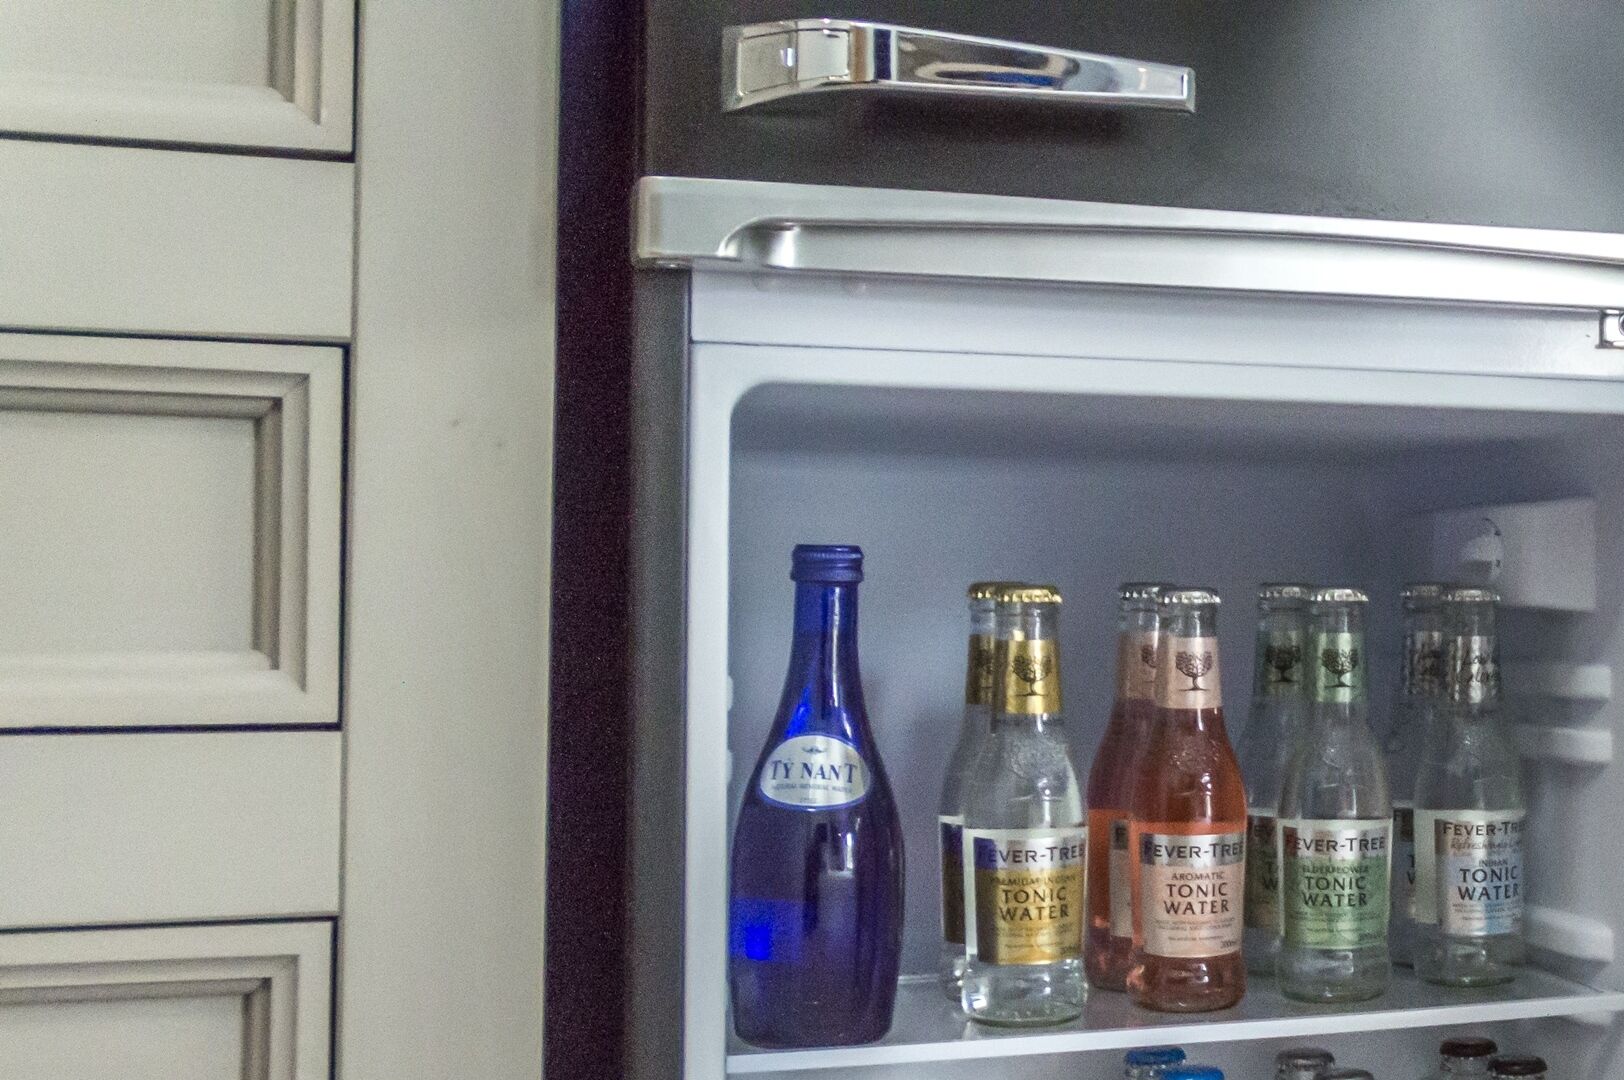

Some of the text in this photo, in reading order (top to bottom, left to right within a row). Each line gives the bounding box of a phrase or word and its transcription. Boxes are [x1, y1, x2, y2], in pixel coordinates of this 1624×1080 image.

[800, 761, 858, 784] NANT
[1170, 871, 1226, 881] AROMATIC
[1303, 875, 1366, 891] TONIC
[1459, 865, 1519, 884] TONIC
[1001, 886, 1067, 905] TONIC
[1165, 882, 1229, 899] TONIC
[1457, 883, 1520, 901] WATER
[1163, 899, 1230, 916] WATER
[1301, 892, 1369, 908] WATER
[1000, 903, 1070, 922] WATER
